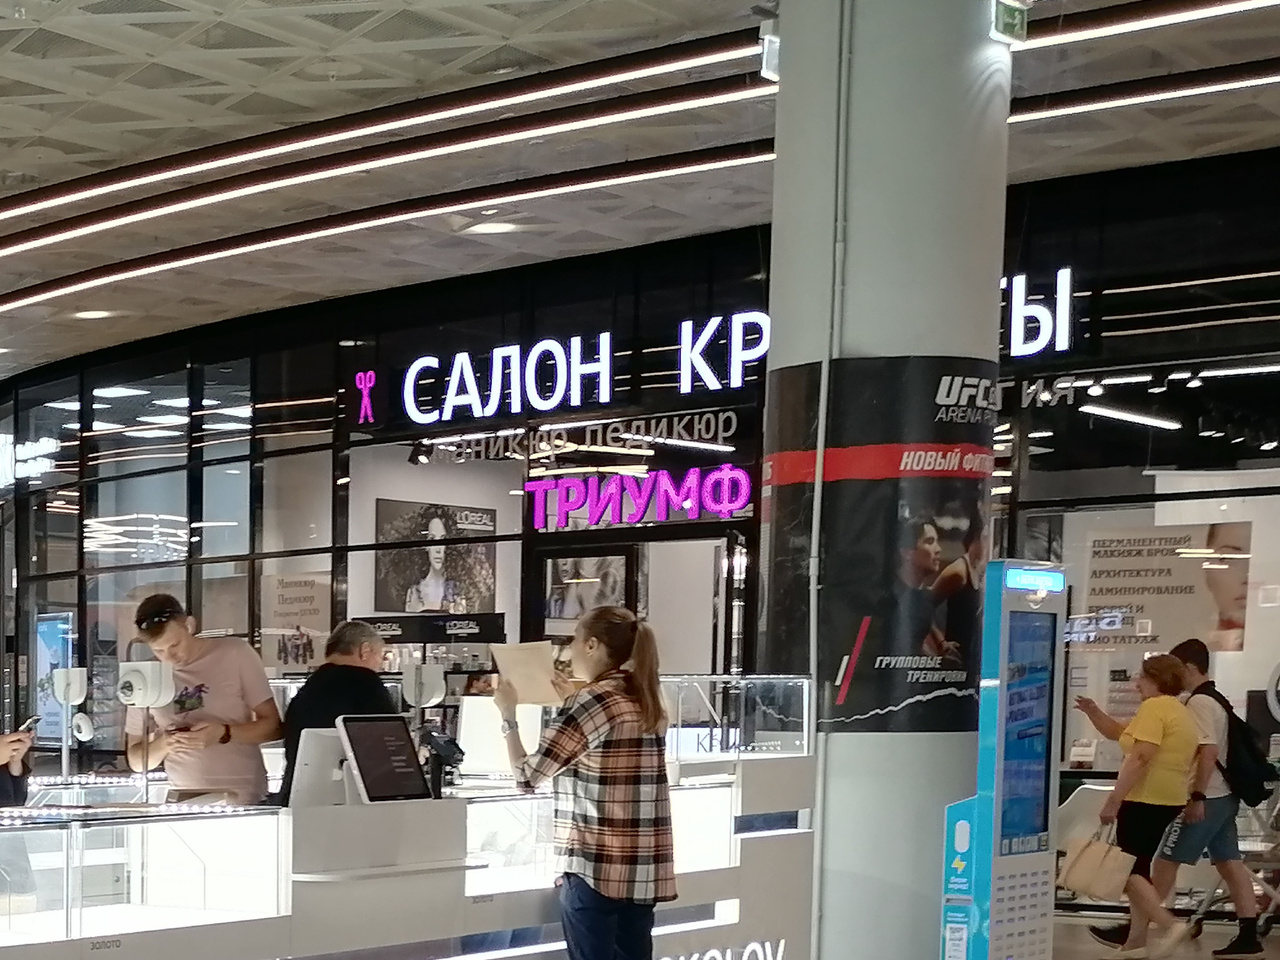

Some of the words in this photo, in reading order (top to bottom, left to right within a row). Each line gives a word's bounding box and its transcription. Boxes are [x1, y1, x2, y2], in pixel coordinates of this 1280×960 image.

[402, 331, 613, 425] САЛОН
[899, 448, 962, 472] НОВЫЙ
[524, 462, 754, 531] ТРИУМФ
[1090, 568, 1173, 580] АРХИТЕКТУРА
[1088, 586, 1196, 597] ЛАМИНИРОВАНИЕ
[874, 656, 943, 669] ГРУППОВЫЕ
